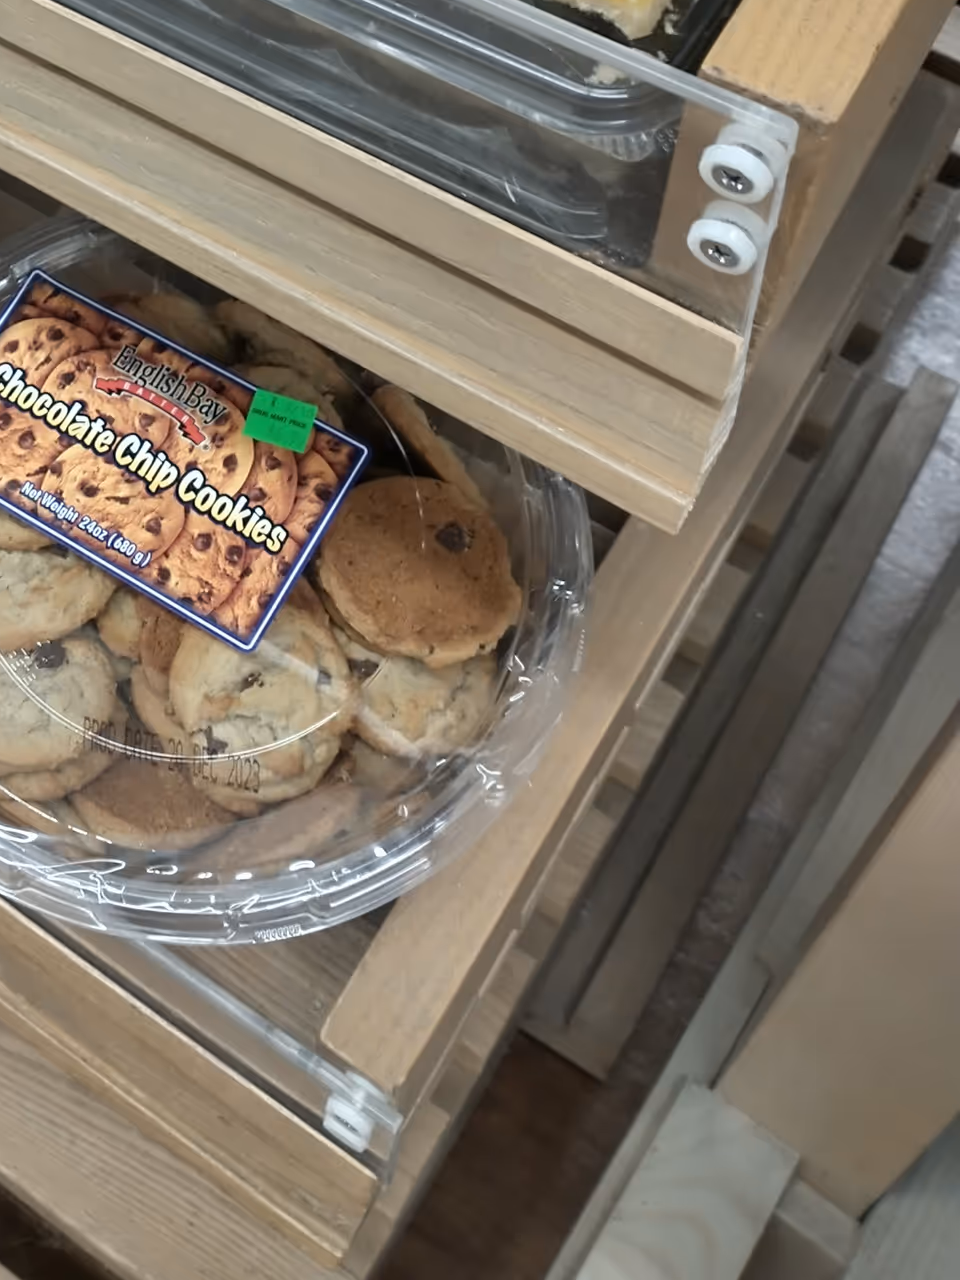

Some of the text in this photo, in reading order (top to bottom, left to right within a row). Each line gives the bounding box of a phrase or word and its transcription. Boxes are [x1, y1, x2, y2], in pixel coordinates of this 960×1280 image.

[123, 382, 188, 423] BATTER
[21, 482, 42, 501] Net
[41, 493, 79, 523] Weight
[78, 517, 108, 541] 24oz
[115, 434, 178, 493] Chip
[178, 469, 287, 552] Cookies
[192, 743, 218, 783] DEC
